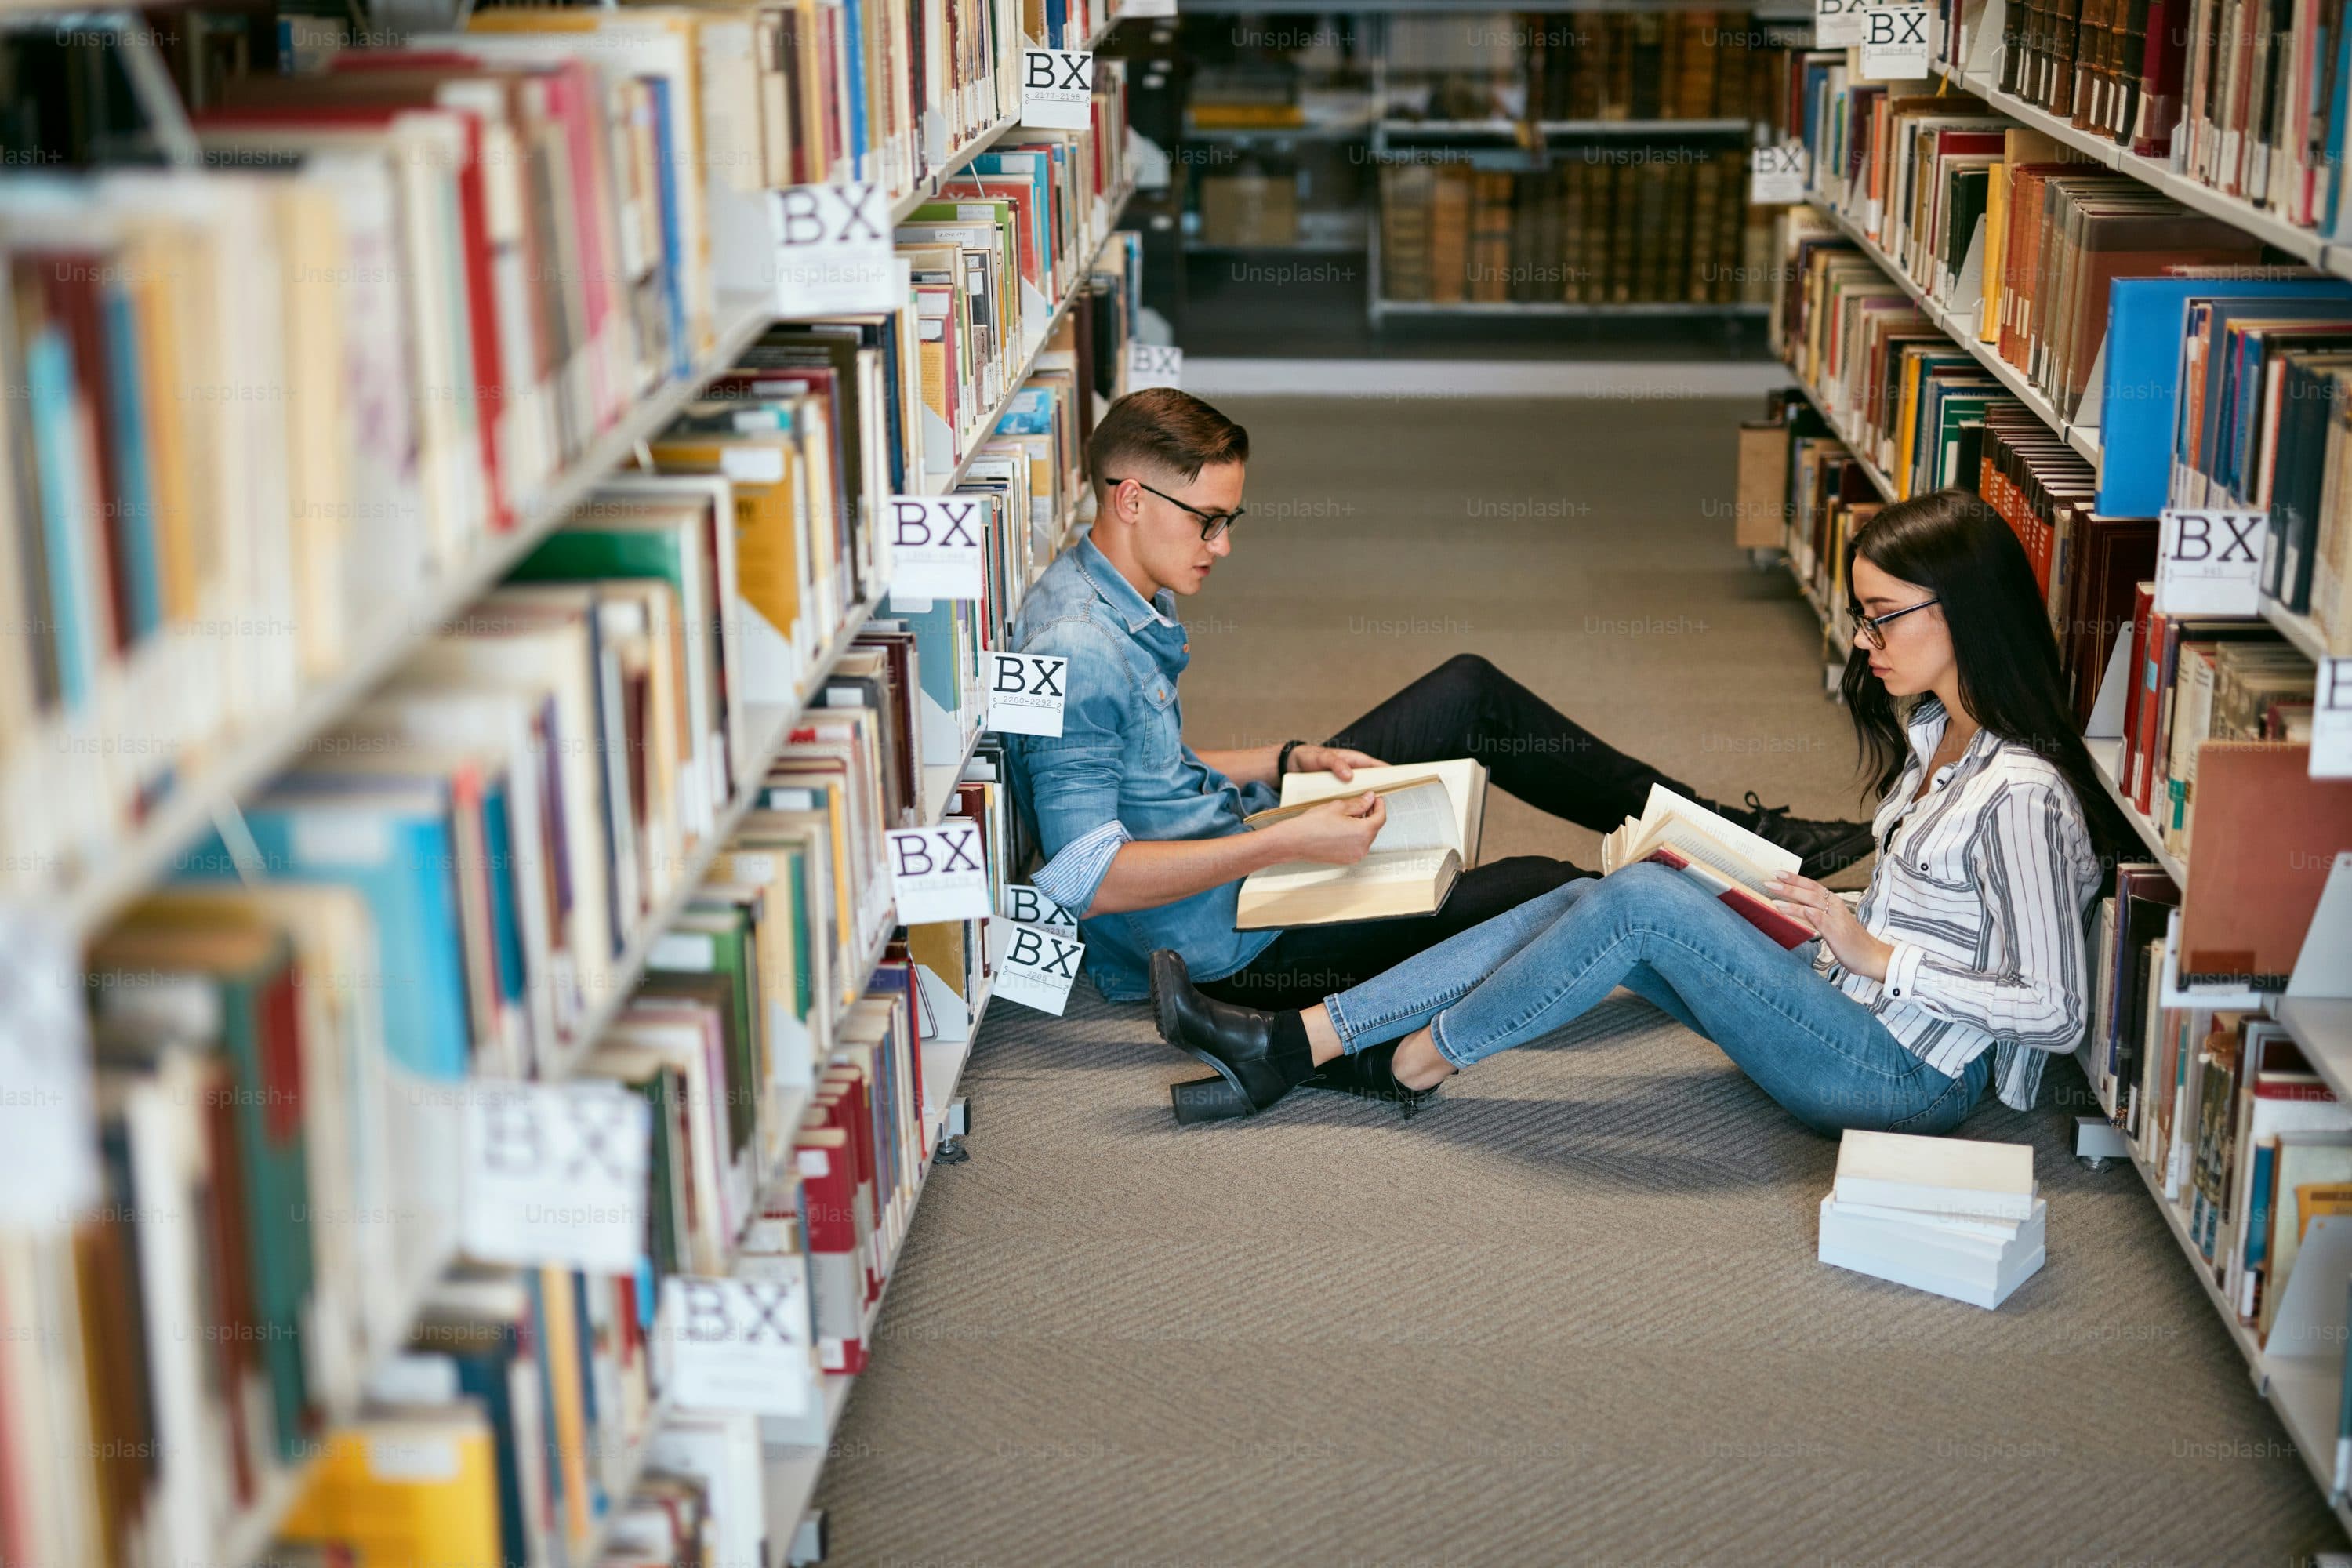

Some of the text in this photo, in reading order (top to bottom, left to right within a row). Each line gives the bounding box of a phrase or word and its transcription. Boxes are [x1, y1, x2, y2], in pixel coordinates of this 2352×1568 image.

[1868, 13, 1927, 45] BX
[1025, 53, 1091, 90] BX
[1034, 91, 1080, 101] 2177-2198
[1758, 147, 1802, 174] BX
[778, 185, 882, 246] BX
[1134, 347, 1179, 376] BX
[892, 502, 978, 547] BX
[2172, 517, 2263, 564] BX
[993, 656, 1065, 696] BX
[1003, 695, 1051, 706] 2200-2292
[891, 830, 981, 877] BX
[1010, 888, 1076, 926] BX
[1007, 927, 1081, 979] BX
[1026, 970, 1048, 982] 2205
[684, 1279, 793, 1344] BX
